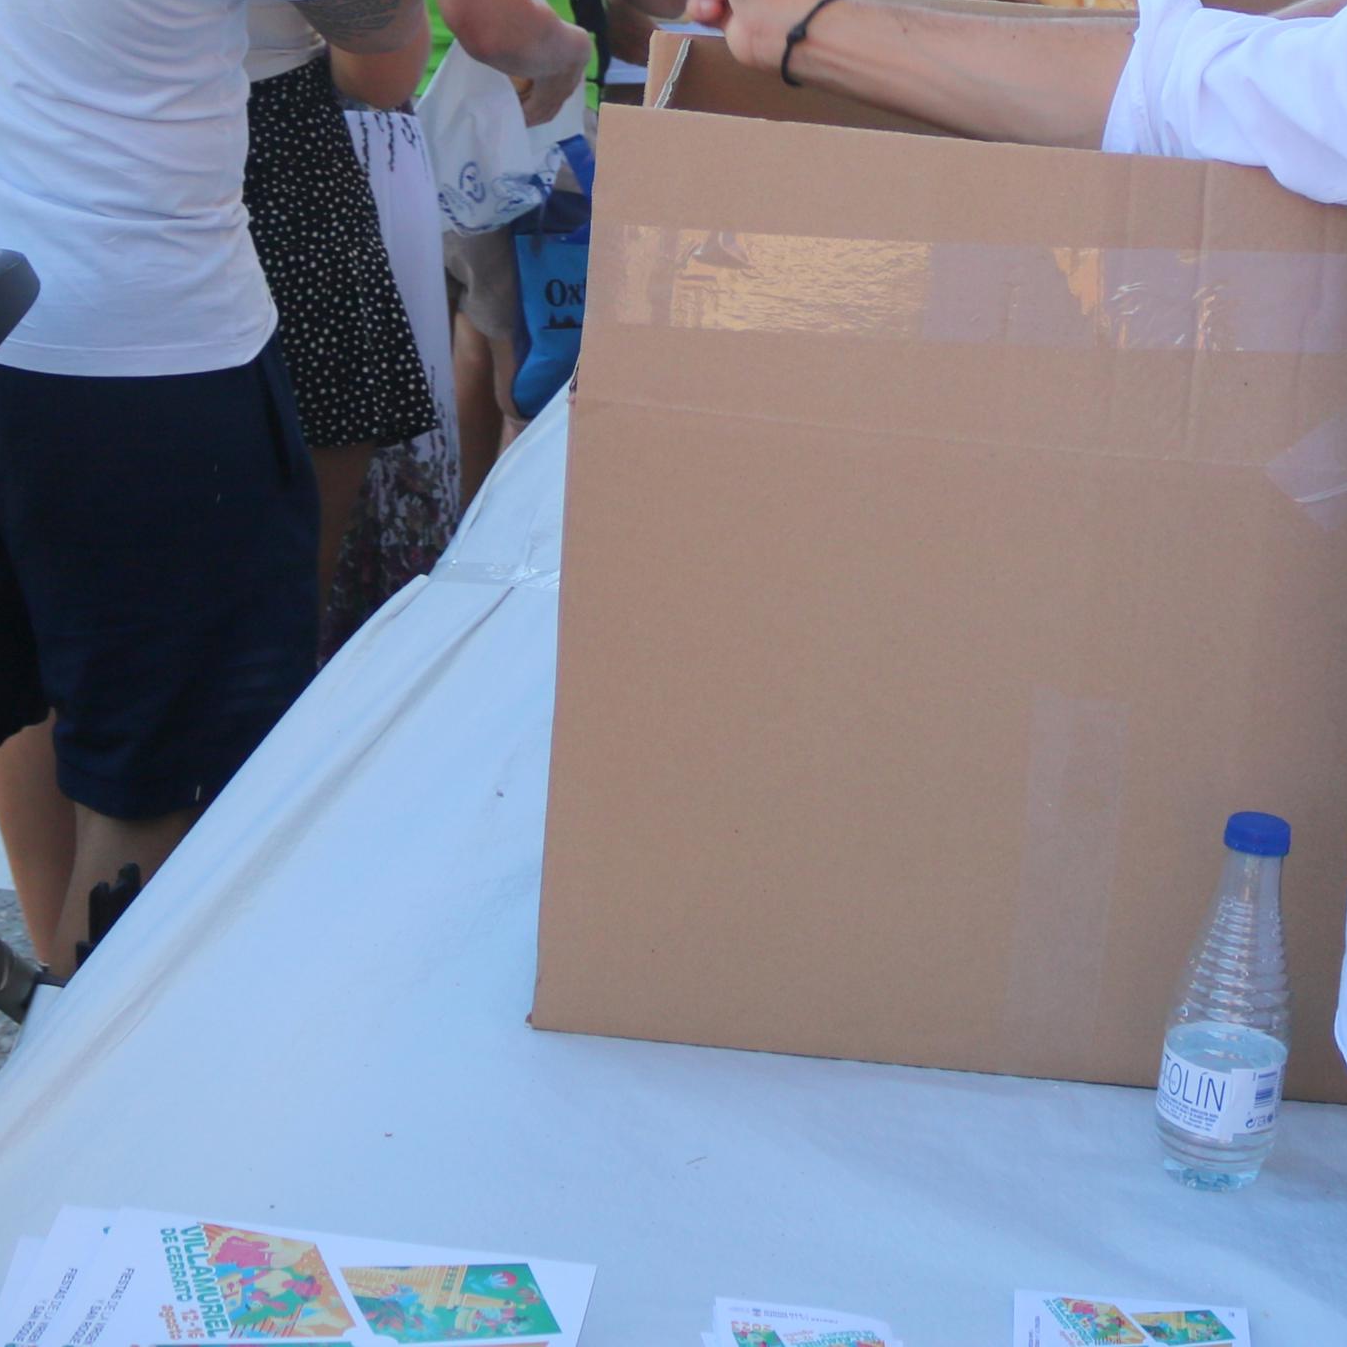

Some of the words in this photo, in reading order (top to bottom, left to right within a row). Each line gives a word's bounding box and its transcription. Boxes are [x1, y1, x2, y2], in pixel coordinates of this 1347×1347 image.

[545, 277, 587, 307] Ox
[160, 1227, 179, 1244] DE
[164, 1245, 193, 1302] CERRATO
[180, 1225, 231, 1338] VILLAMURIEL
